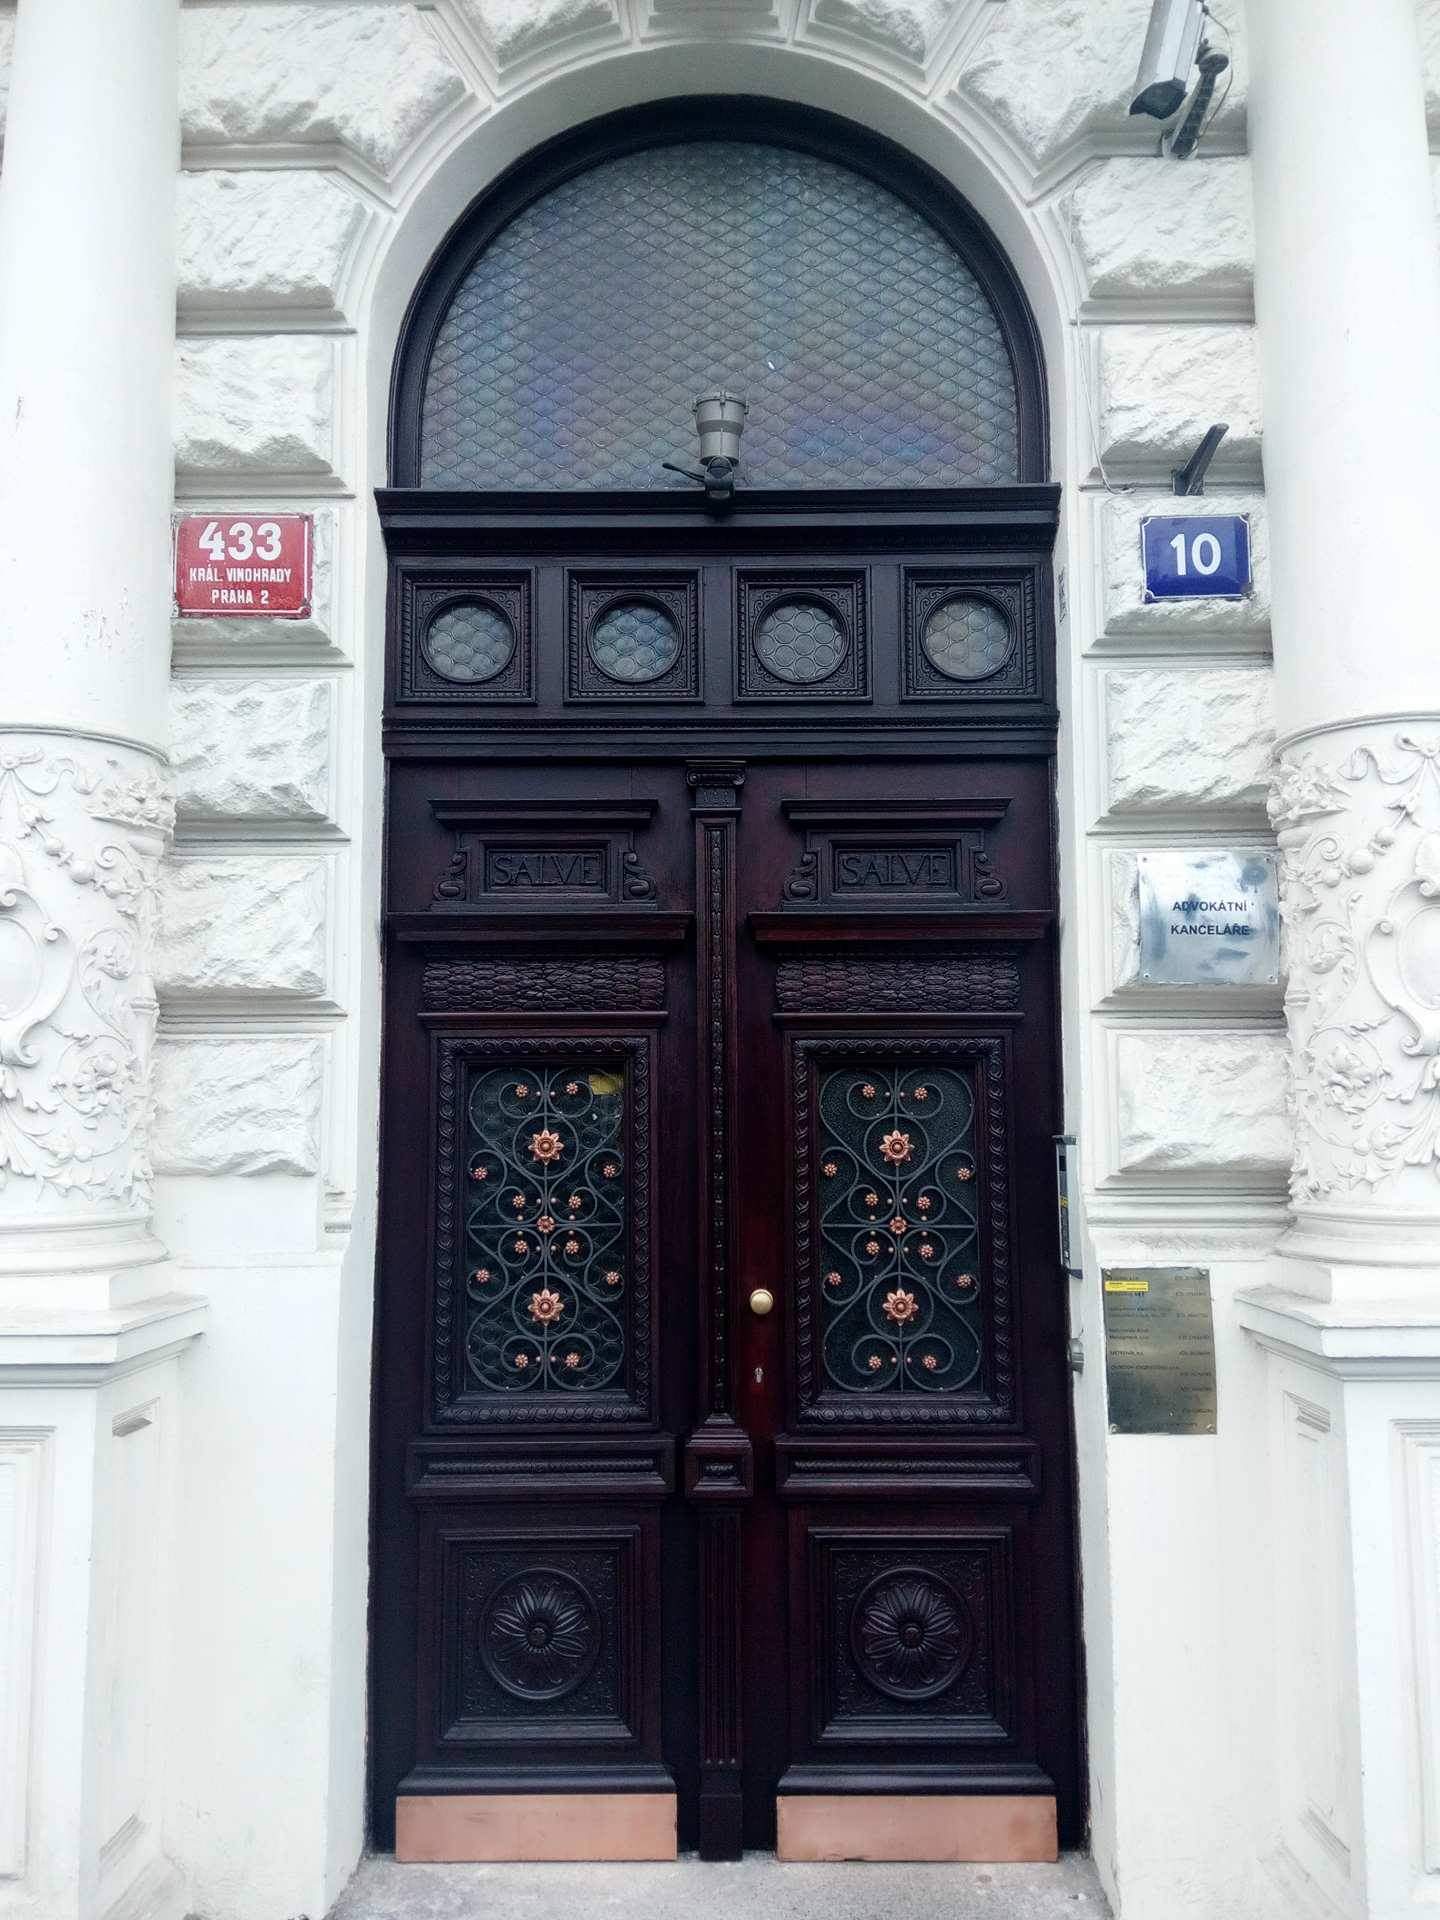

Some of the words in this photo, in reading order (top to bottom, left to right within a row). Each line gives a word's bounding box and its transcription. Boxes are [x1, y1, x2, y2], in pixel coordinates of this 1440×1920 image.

[198, 522, 282, 561] 433
[1170, 533, 1222, 576] 10
[226, 567, 292, 583] VINOHRADY
[211, 589, 254, 604] PRAHA
[260, 589, 269, 604] 2
[495, 855, 600, 886] SALVE
[842, 854, 948, 886] SALVE
[1172, 899, 1247, 912] ADVOKÁTNÍ
[1170, 922, 1250, 936] KANCELÁŘE
